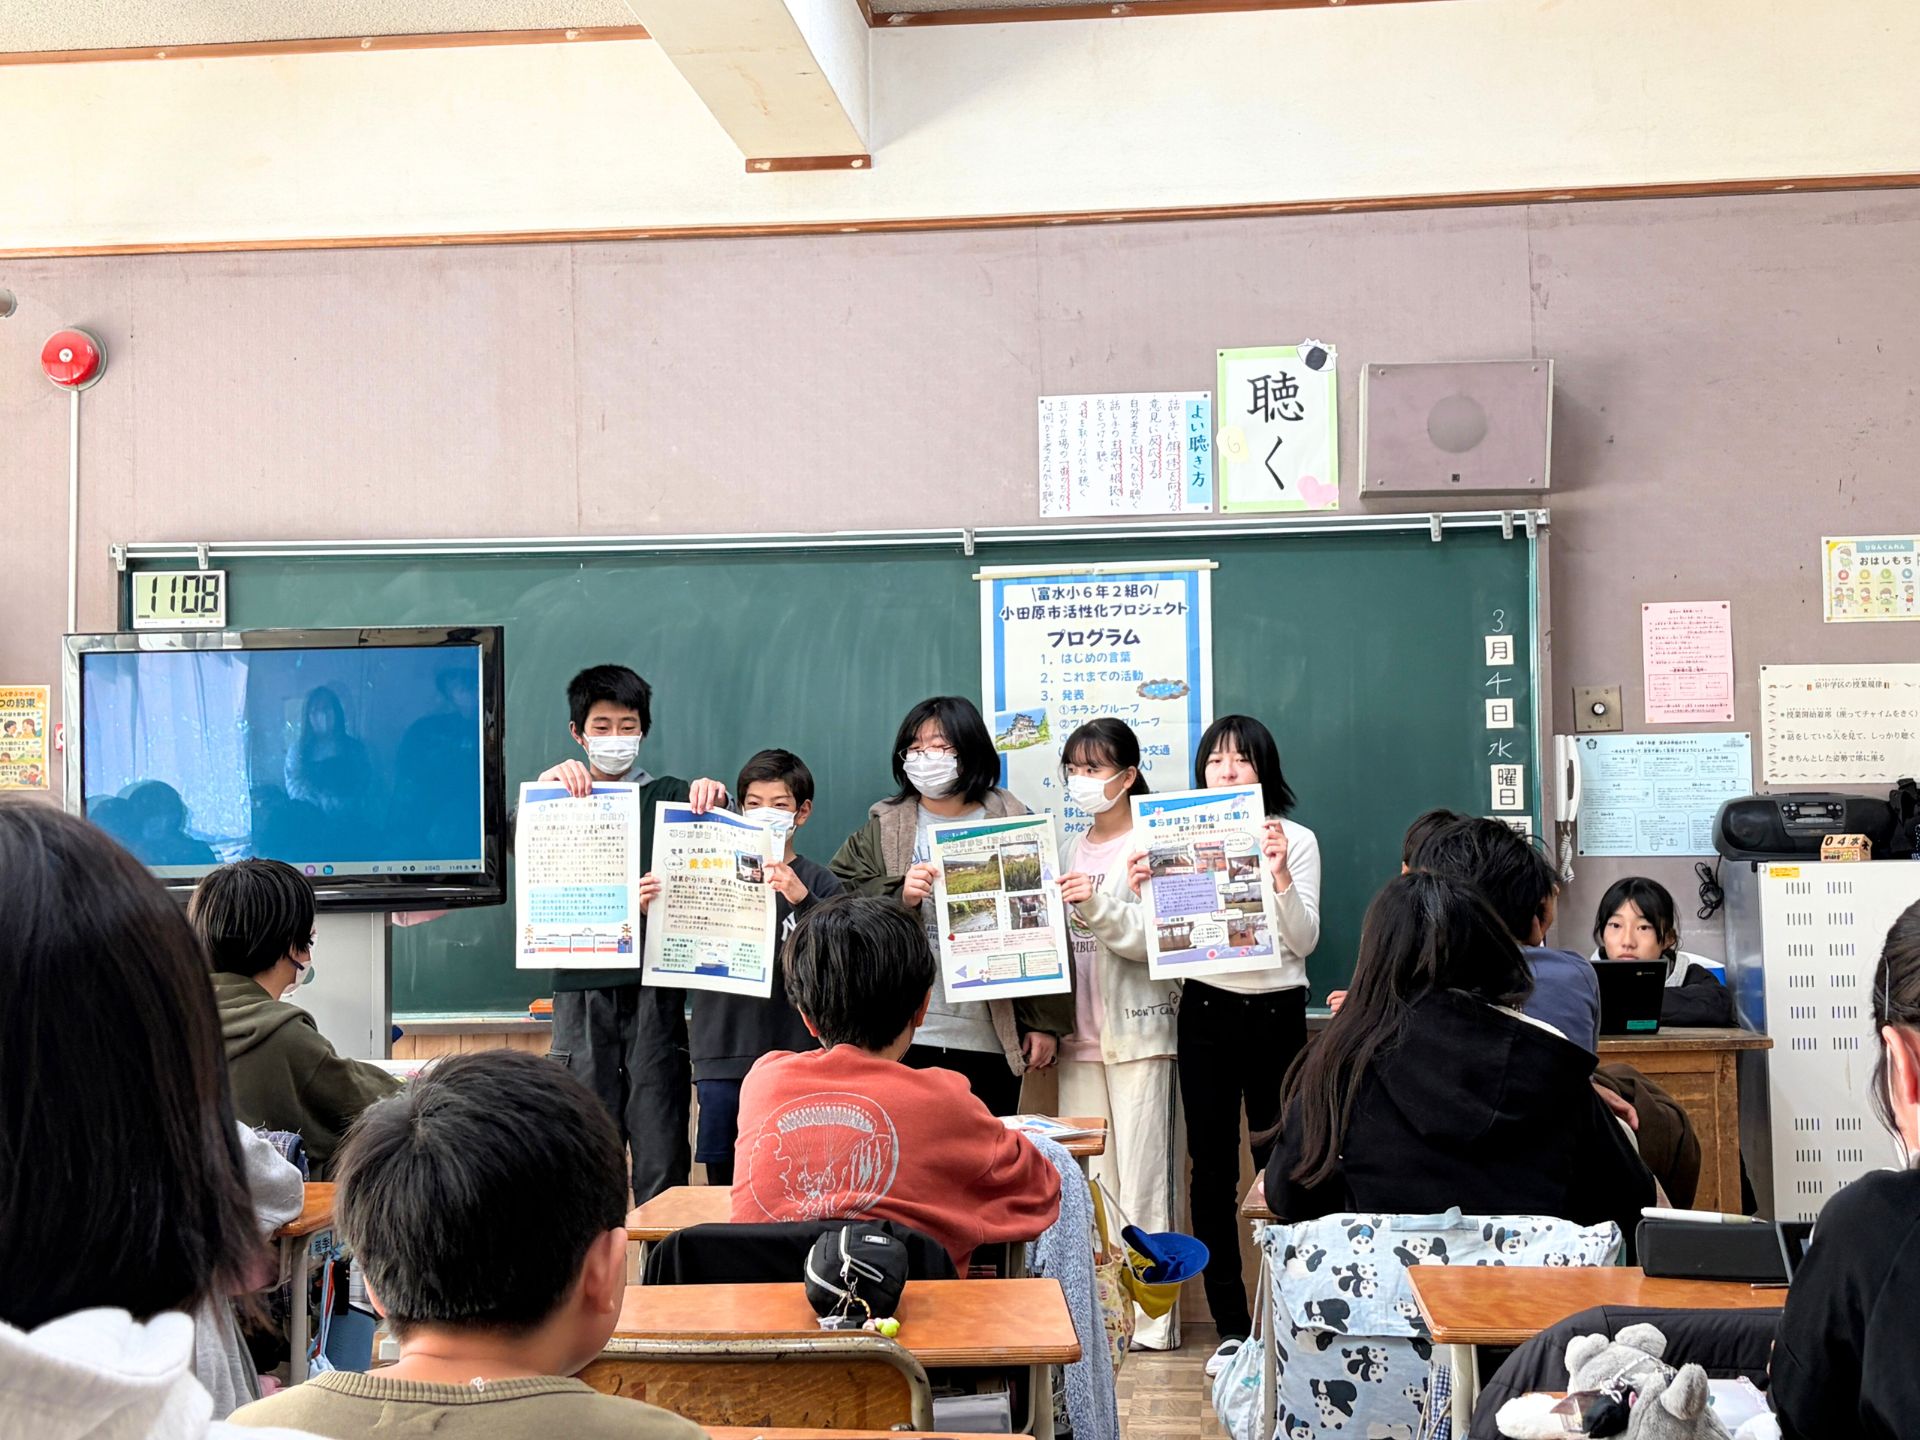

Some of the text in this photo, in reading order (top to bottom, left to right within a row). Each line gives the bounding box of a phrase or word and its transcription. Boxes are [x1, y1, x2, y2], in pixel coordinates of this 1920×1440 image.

[1246, 371, 1304, 490] 聴く
[1188, 404, 1209, 488] よい聴き方
[1860, 556, 1911, 566] おはしもち
[1000, 602, 1187, 621] 小田原市活性化プロジェクト
[1047, 628, 1141, 648] プログラム
[1061, 651, 1131, 664] はじめの言葉
[1062, 670, 1144, 682] これまでの活動
[1062, 689, 1085, 701] 発表
